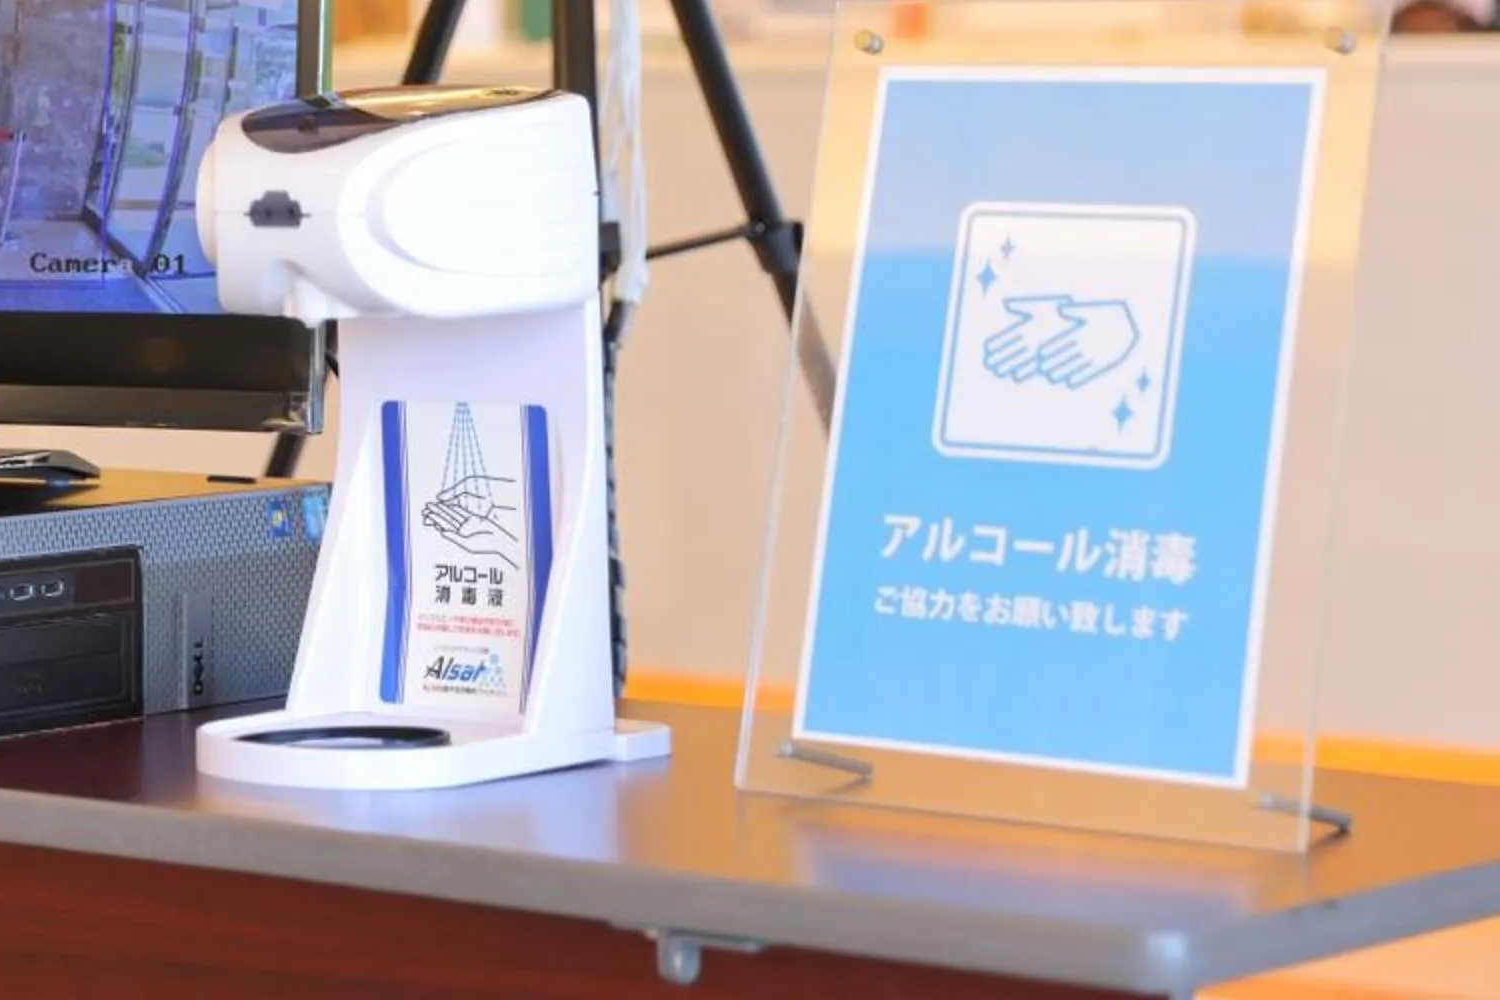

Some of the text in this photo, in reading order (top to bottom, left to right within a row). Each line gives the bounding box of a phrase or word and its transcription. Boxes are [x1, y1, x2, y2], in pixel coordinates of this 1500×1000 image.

[434, 564, 505, 585] アルコール
[881, 514, 1197, 585] アルコール消毒
[873, 586, 1189, 641] ご協力をお願い致します
